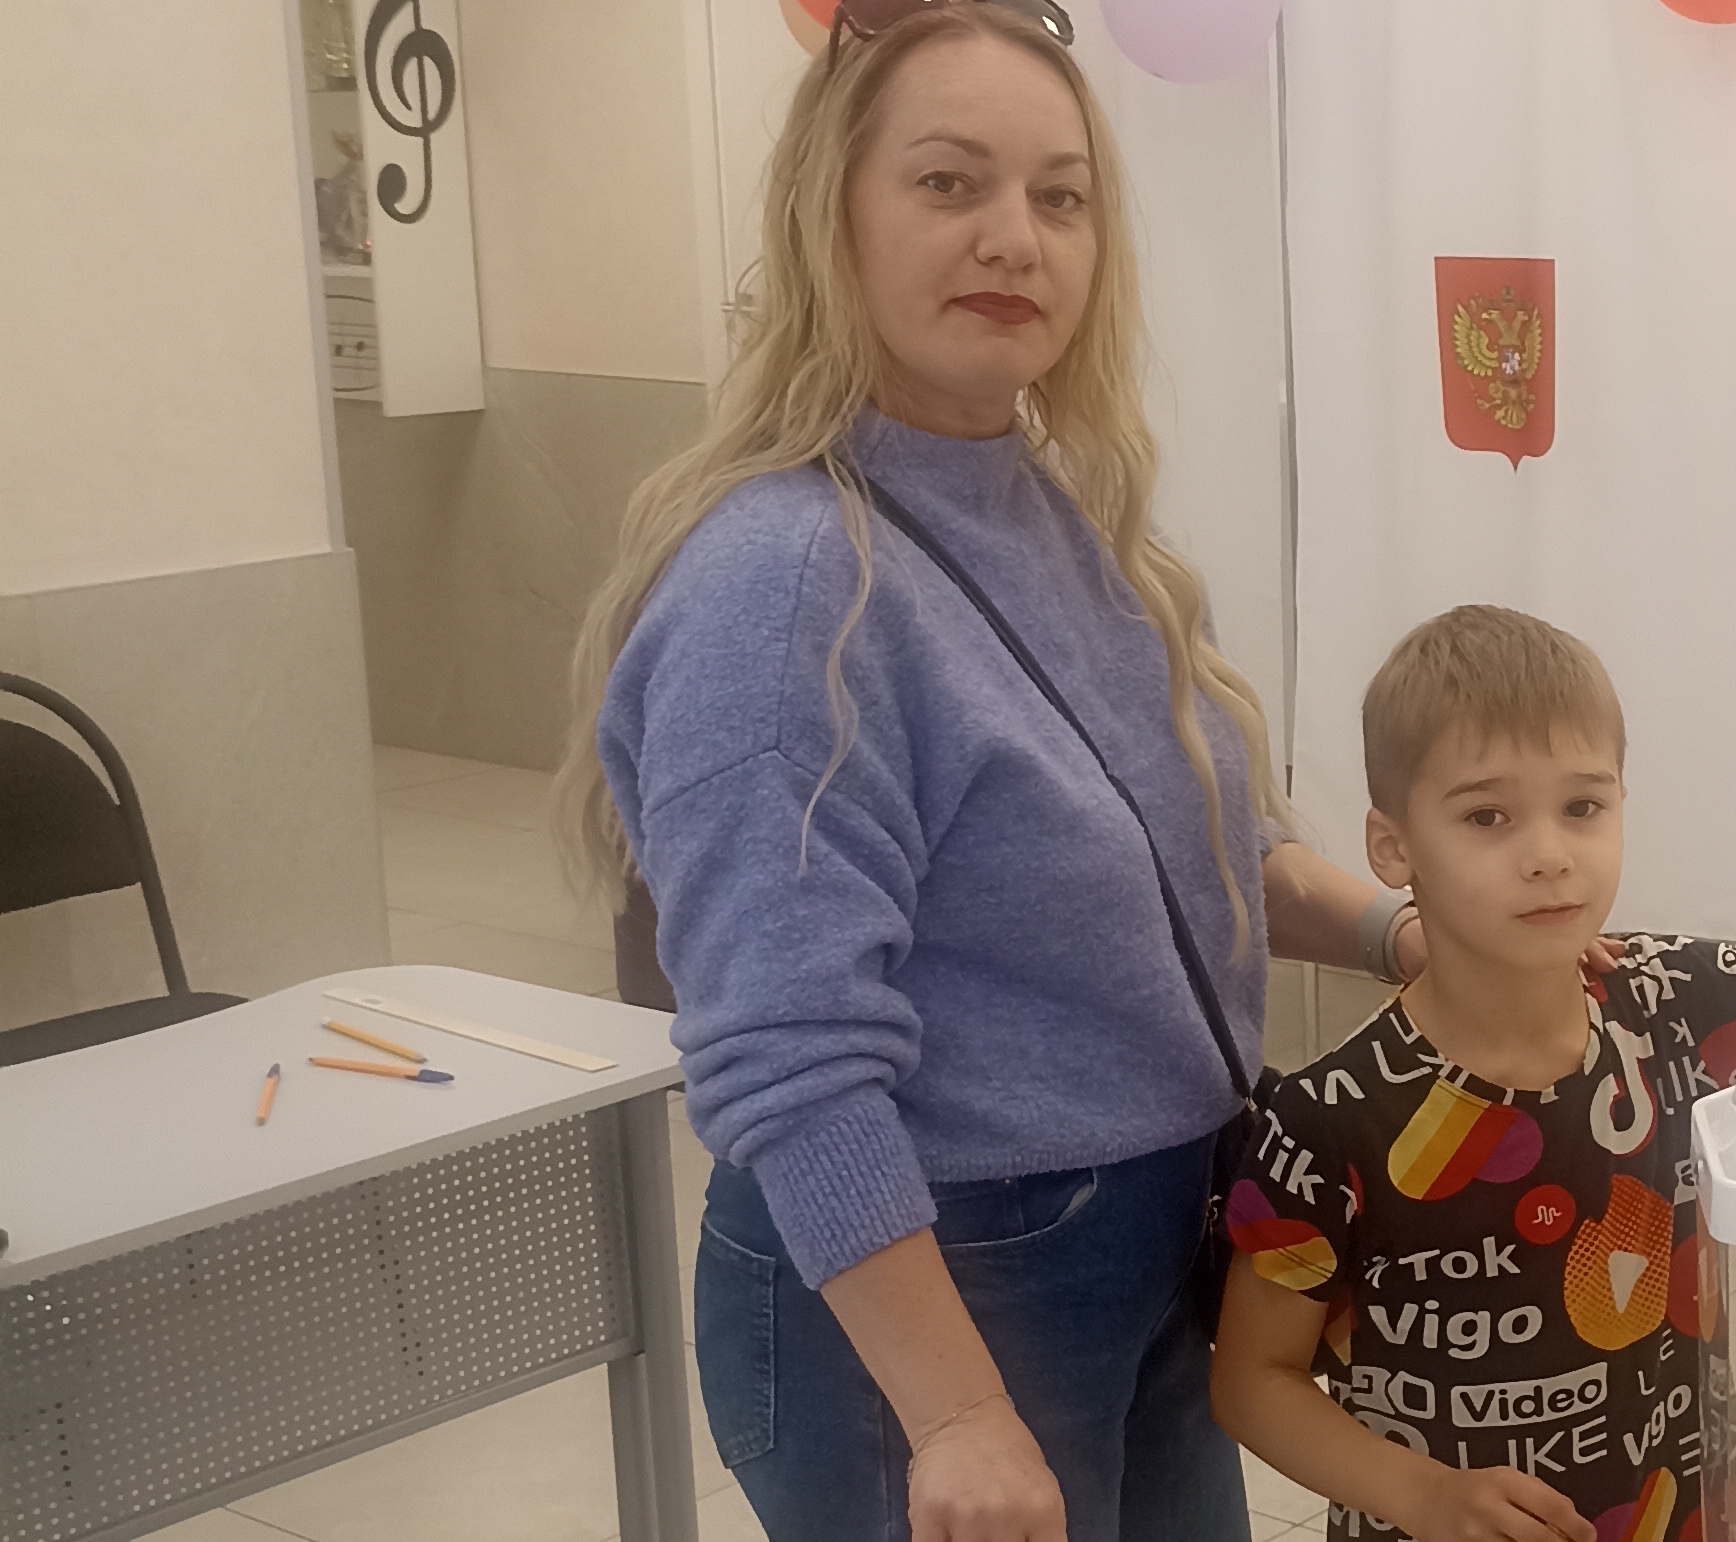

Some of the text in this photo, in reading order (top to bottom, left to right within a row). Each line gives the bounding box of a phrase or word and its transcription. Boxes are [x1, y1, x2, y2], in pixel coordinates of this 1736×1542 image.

[1656, 1055, 1720, 1115] LIK
[1257, 1108, 1325, 1205] Tik
[1398, 1235, 1521, 1282] Tok
[1367, 1299, 1543, 1360] Vigo
[1459, 1378, 1603, 1423] Video
